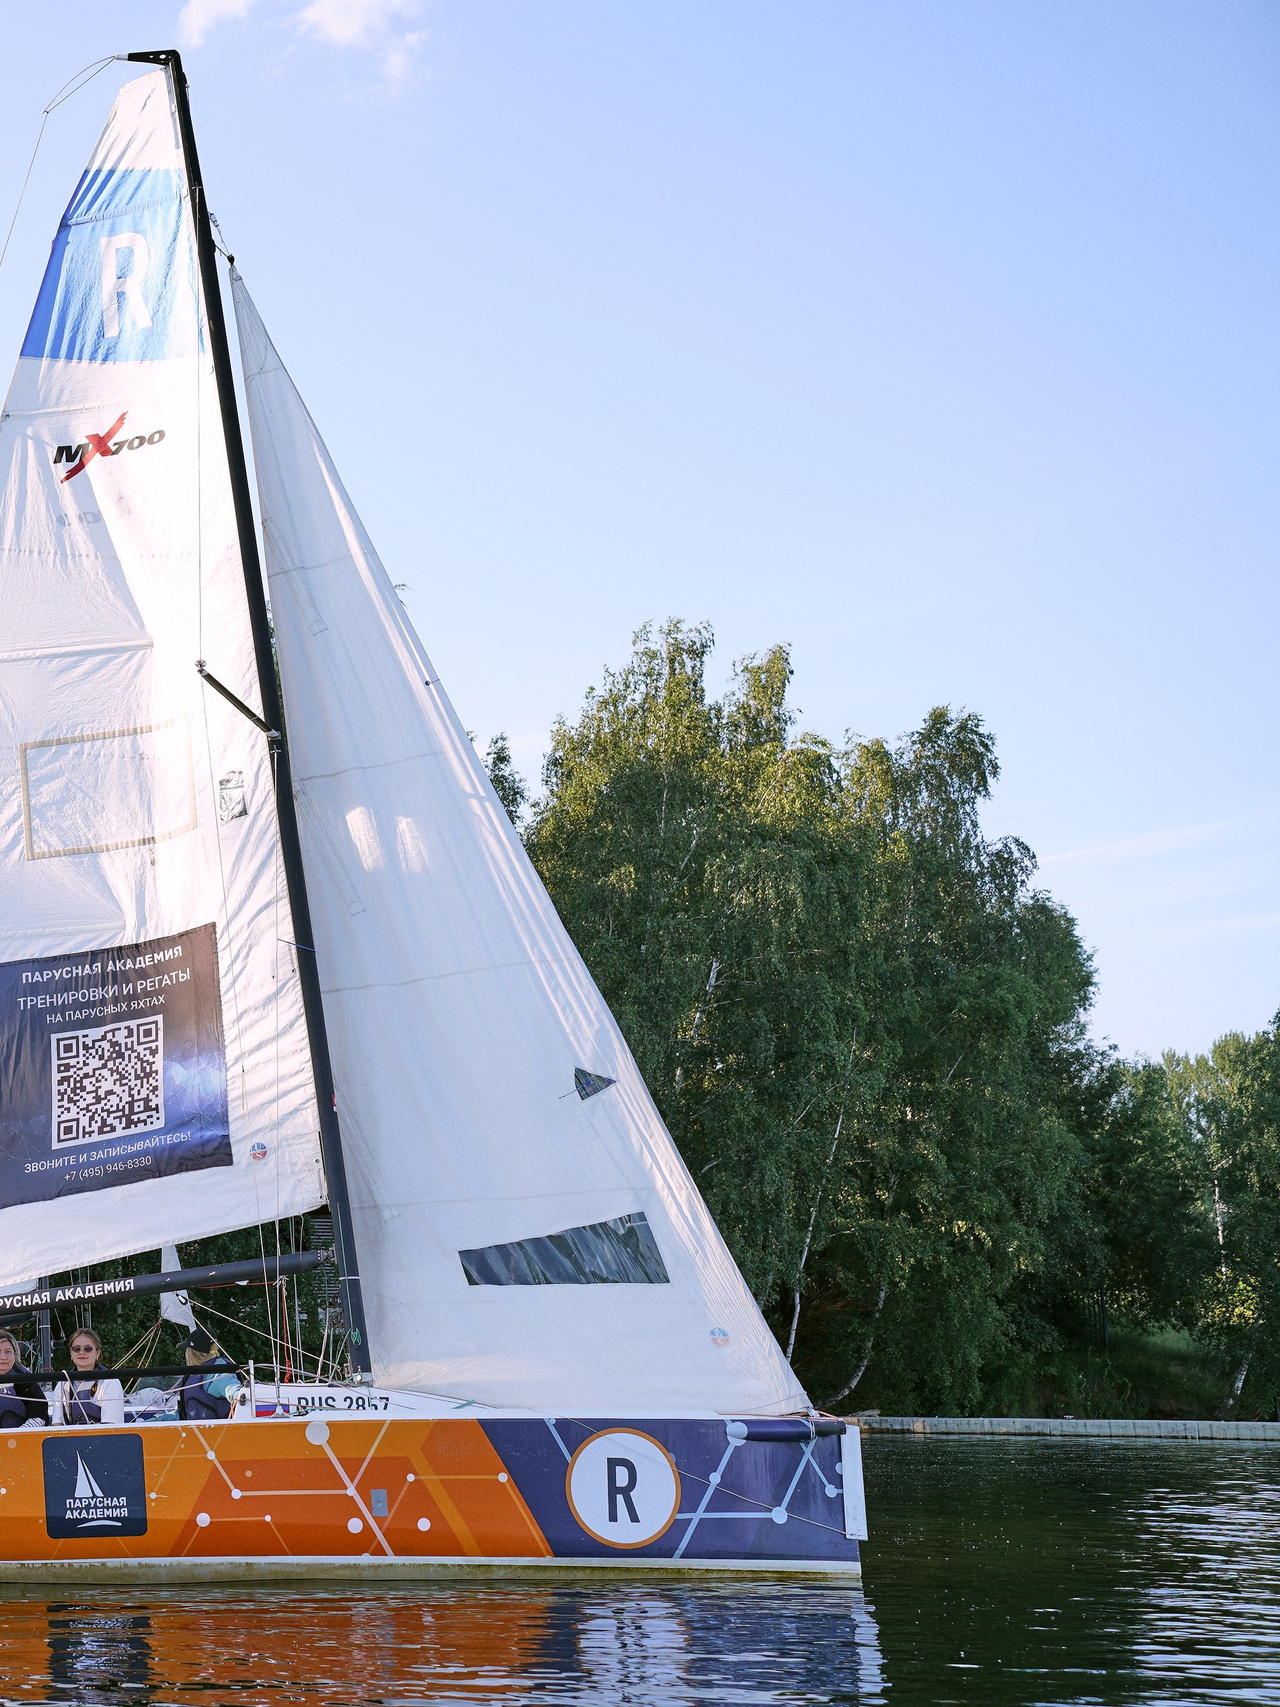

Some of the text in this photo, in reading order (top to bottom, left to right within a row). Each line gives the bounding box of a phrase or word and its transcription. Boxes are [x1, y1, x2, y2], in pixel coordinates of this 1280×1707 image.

[101, 232, 153, 338] R
[53, 411, 166, 484] MX700
[22, 945, 183, 984] ПАРУСНАЯ АКАДЕМИЯ
[17, 967, 191, 1011] ТРЕНИРОВКИ И РЕГАТЫ
[46, 994, 166, 1024] НА ПАРУСНЫХ ЯХТАХ
[24, 1131, 192, 1174] ЗВОНИТЕ И ЗАПИСЫВАЙТЕСЬ!
[64, 1155, 152, 1181] +7 (495) 946-8330
[55, 1278, 135, 1302] АКАДЕМИЯ
[66, 1496, 127, 1509] ПАРУСНАЯ
[606, 1457, 641, 1523] R
[65, 1507, 128, 1520] АКАДЕМИЯ
